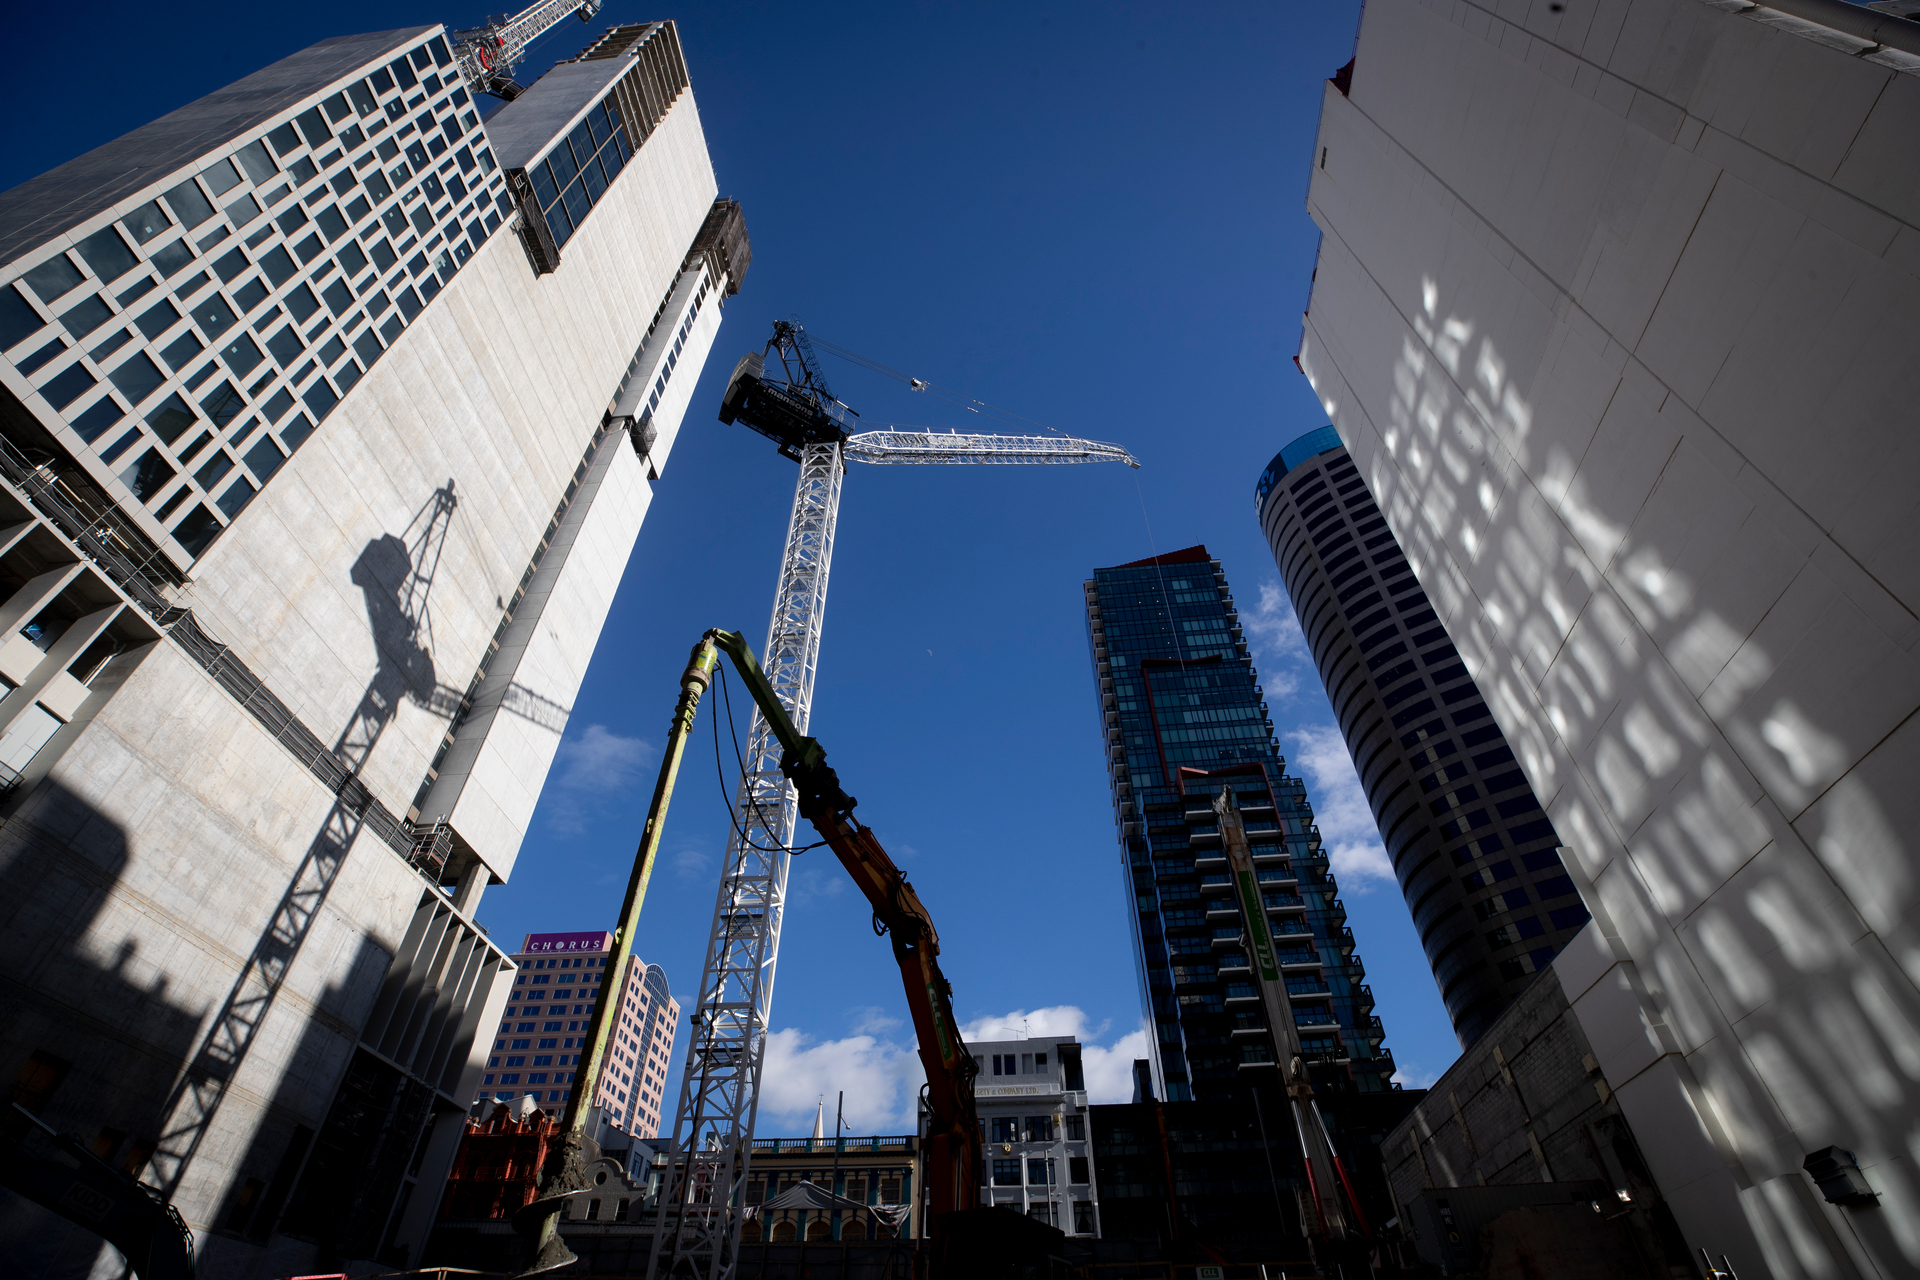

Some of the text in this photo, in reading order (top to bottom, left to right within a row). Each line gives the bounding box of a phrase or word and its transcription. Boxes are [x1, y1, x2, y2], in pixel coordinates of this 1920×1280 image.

[767, 387, 814, 417] mansons
[531, 940, 600, 951] CHORUS
[1257, 943, 1275, 970] CLL
[929, 988, 942, 1025] CLL
[976, 1087, 991, 1096] GETY
[997, 1086, 1024, 1096] COMPANY
[67, 1184, 110, 1213] KIDD
